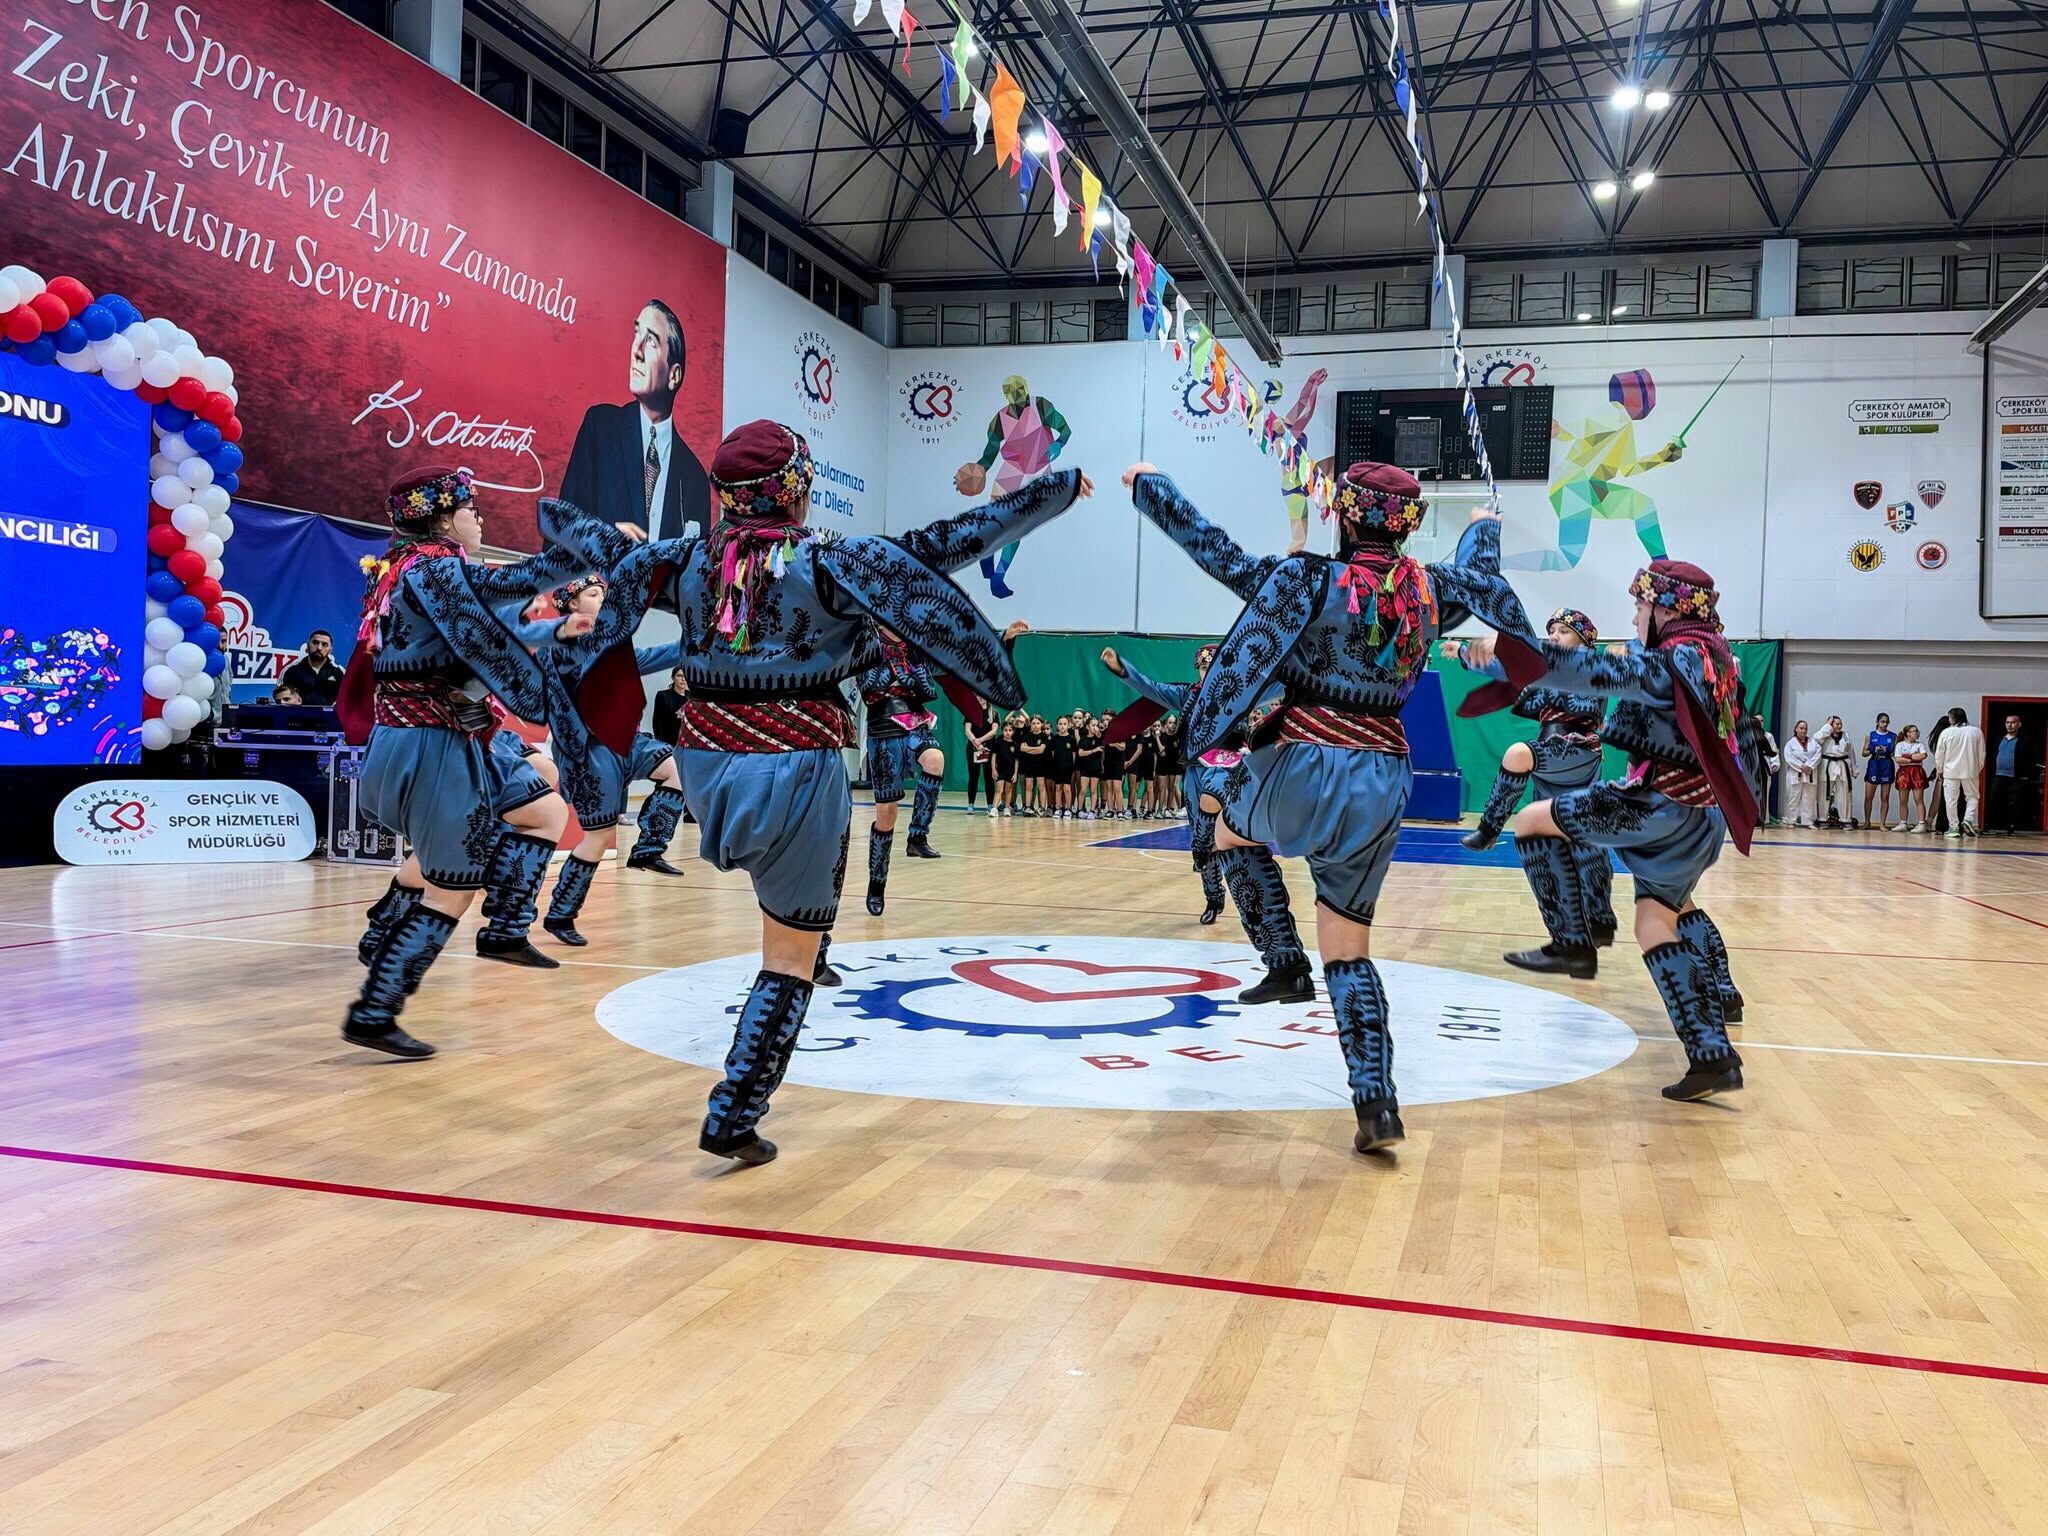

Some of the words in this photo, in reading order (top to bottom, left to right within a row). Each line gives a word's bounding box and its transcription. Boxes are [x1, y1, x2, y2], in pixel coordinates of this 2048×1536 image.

[63, 0, 149, 40] en
[166, 5, 390, 164] Sporcunun
[12, 19, 147, 140] Zeki,
[170, 100, 295, 199] Çevik
[305, 173, 345, 219] ve
[351, 187, 430, 257] Aynı
[439, 223, 577, 324] Zamanda
[2, 122, 275, 274] Ahlaklısını
[1470, 348, 1549, 375] ÇERKEZKÖY
[900, 371, 964, 395] ÇERKEZKÖY
[1855, 401, 1905, 412] ÇERKEZKÖY
[1907, 401, 1946, 410] AMATÖR
[1866, 411, 1889, 419] SPOR
[1891, 410, 1934, 419] KULÜPLERİ
[2002, 399, 2046, 408] ÇERKEZKÖY
[1195, 435, 1216, 443] 1911
[1885, 425, 1912, 433] FUTBOL
[814, 460, 865, 493] cularımıza
[811, 489, 822, 506] ar
[825, 490, 854, 517] Dileriz
[73, 788, 158, 812] ÇERKEZKÖY
[187, 790, 257, 808] GENÇLİK
[261, 793, 280, 805] VE
[168, 815, 211, 827] SPOR
[216, 812, 300, 827] HİZMETLERİ
[187, 833, 286, 849] MÜDÜRLÜĞÜ
[1436, 1004, 1501, 1043] 1911
